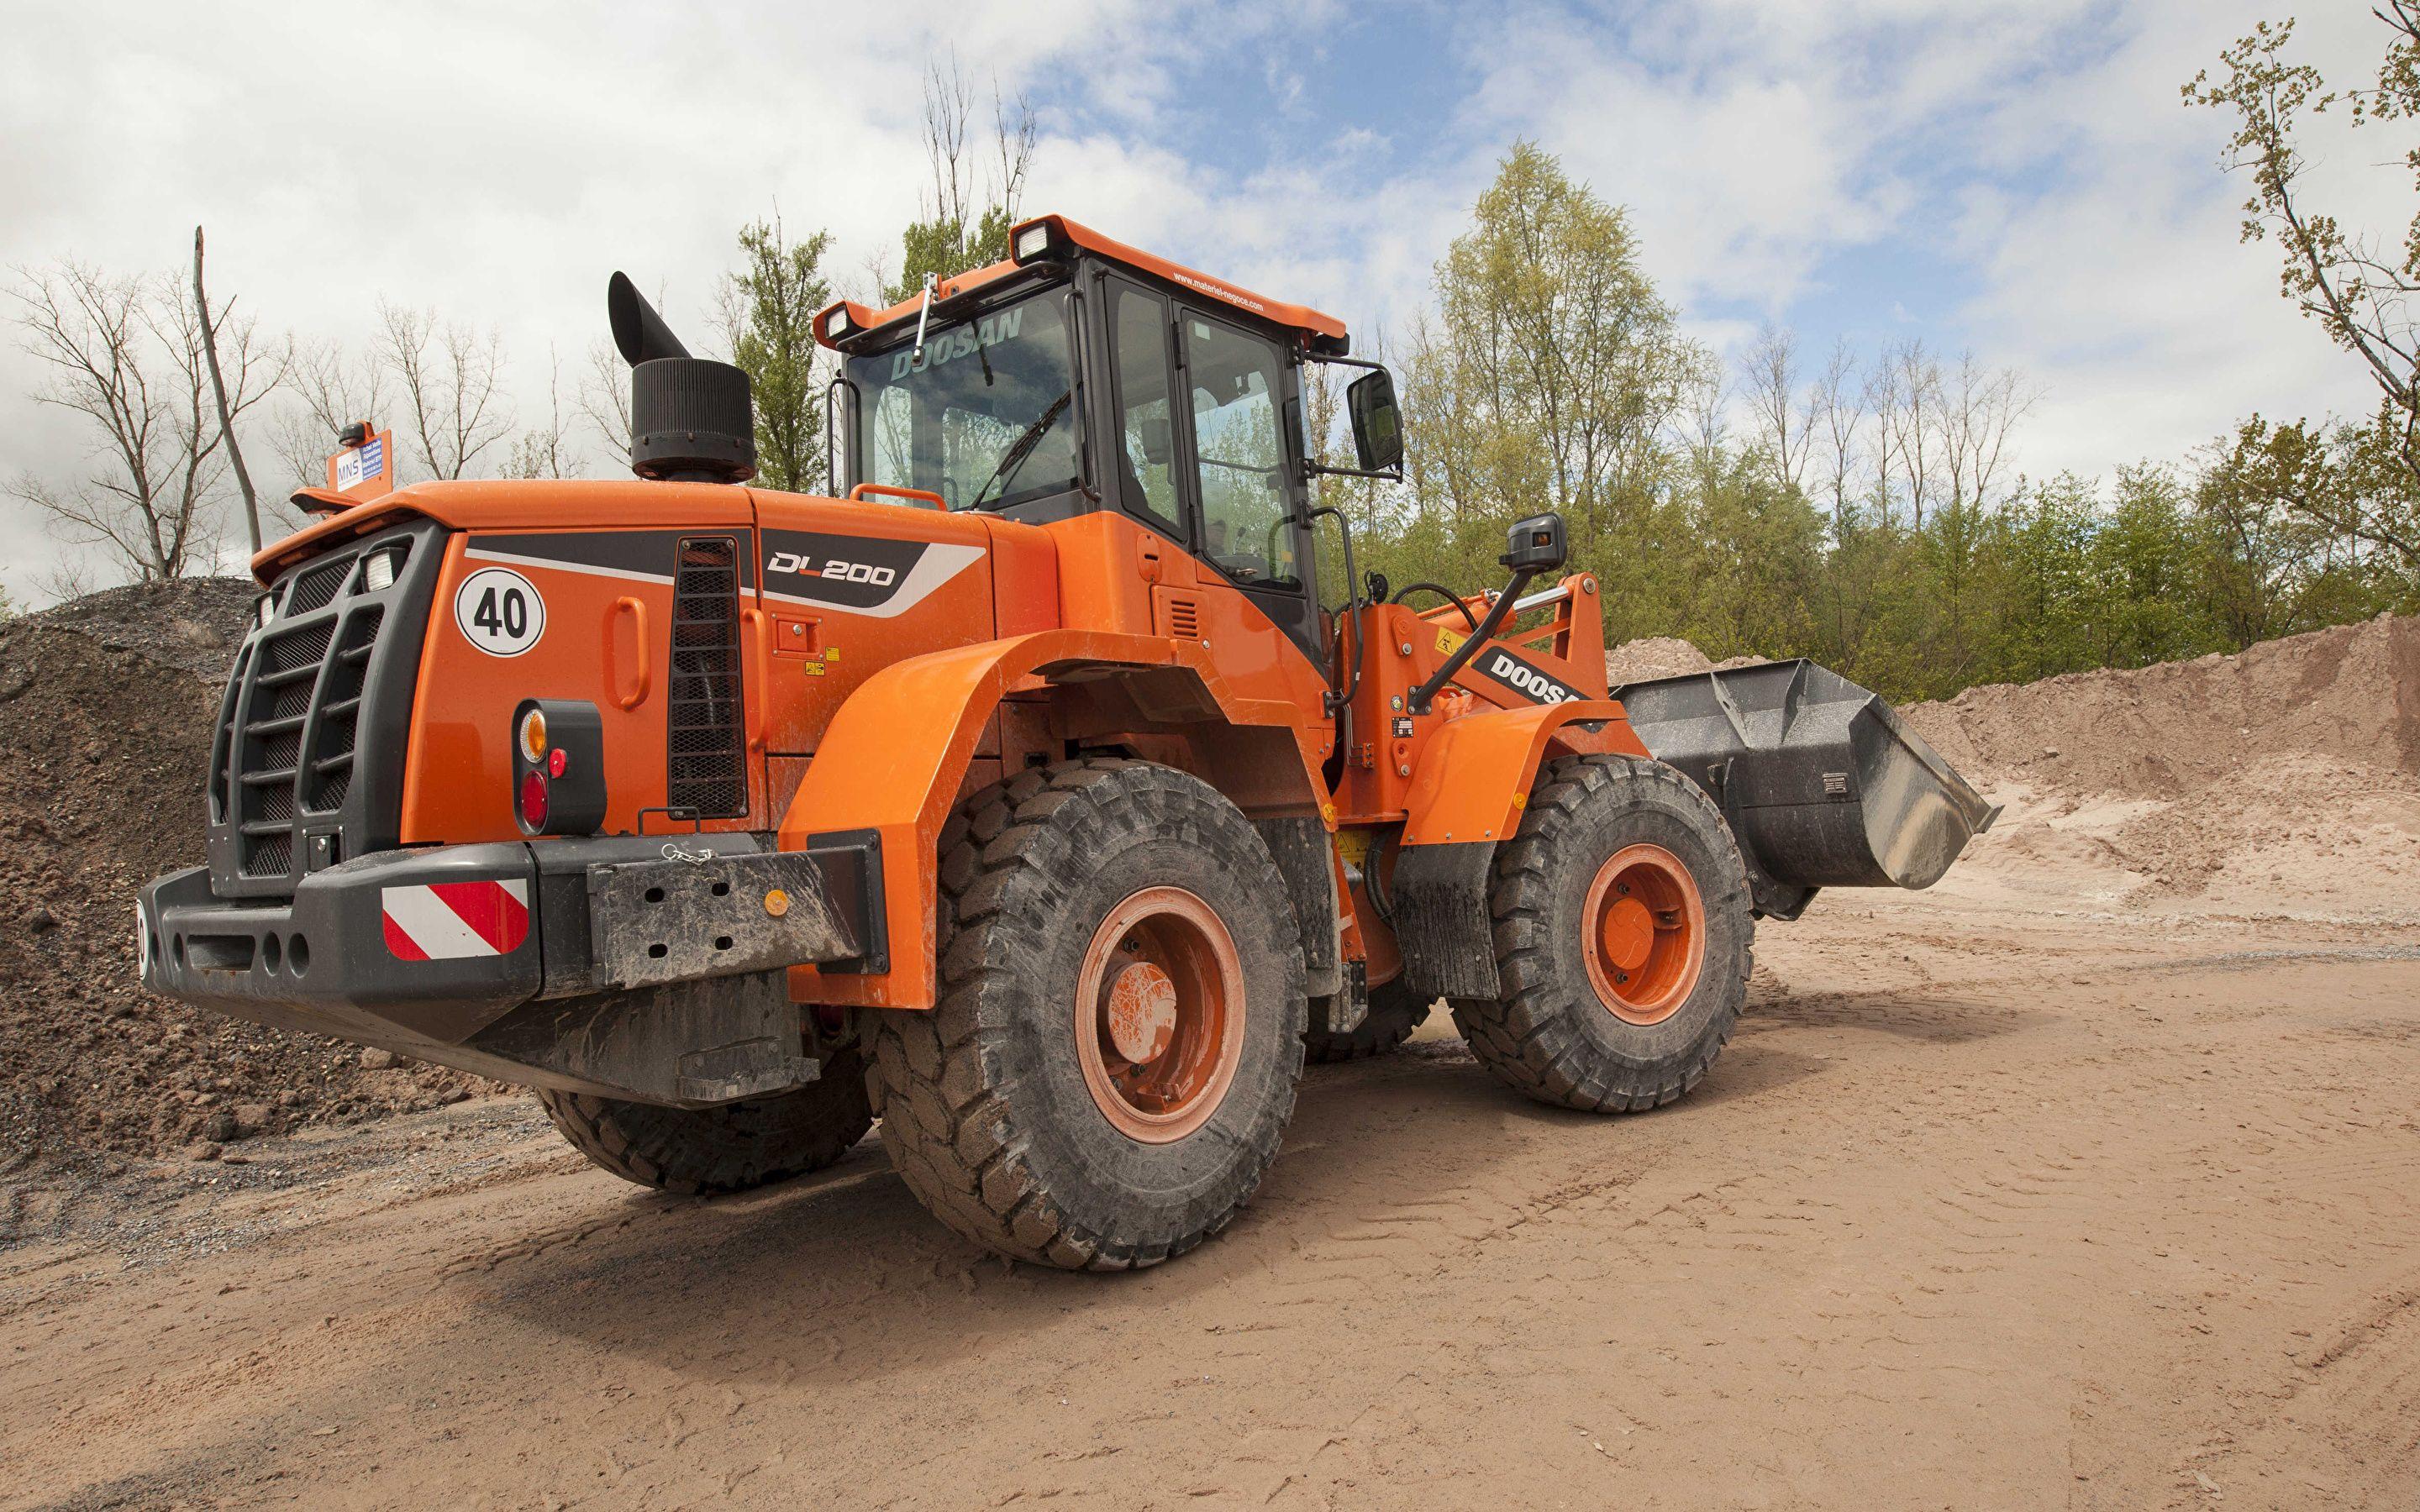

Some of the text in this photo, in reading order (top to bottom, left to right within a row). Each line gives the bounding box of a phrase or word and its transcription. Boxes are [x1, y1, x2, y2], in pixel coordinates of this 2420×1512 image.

[1173, 272, 1264, 312] www.materiel-negoce.com
[891, 307, 1023, 381] DOOSAN
[339, 459, 359, 483] MNS
[474, 587, 527, 638] 40
[1491, 654, 1580, 705] DOOS
